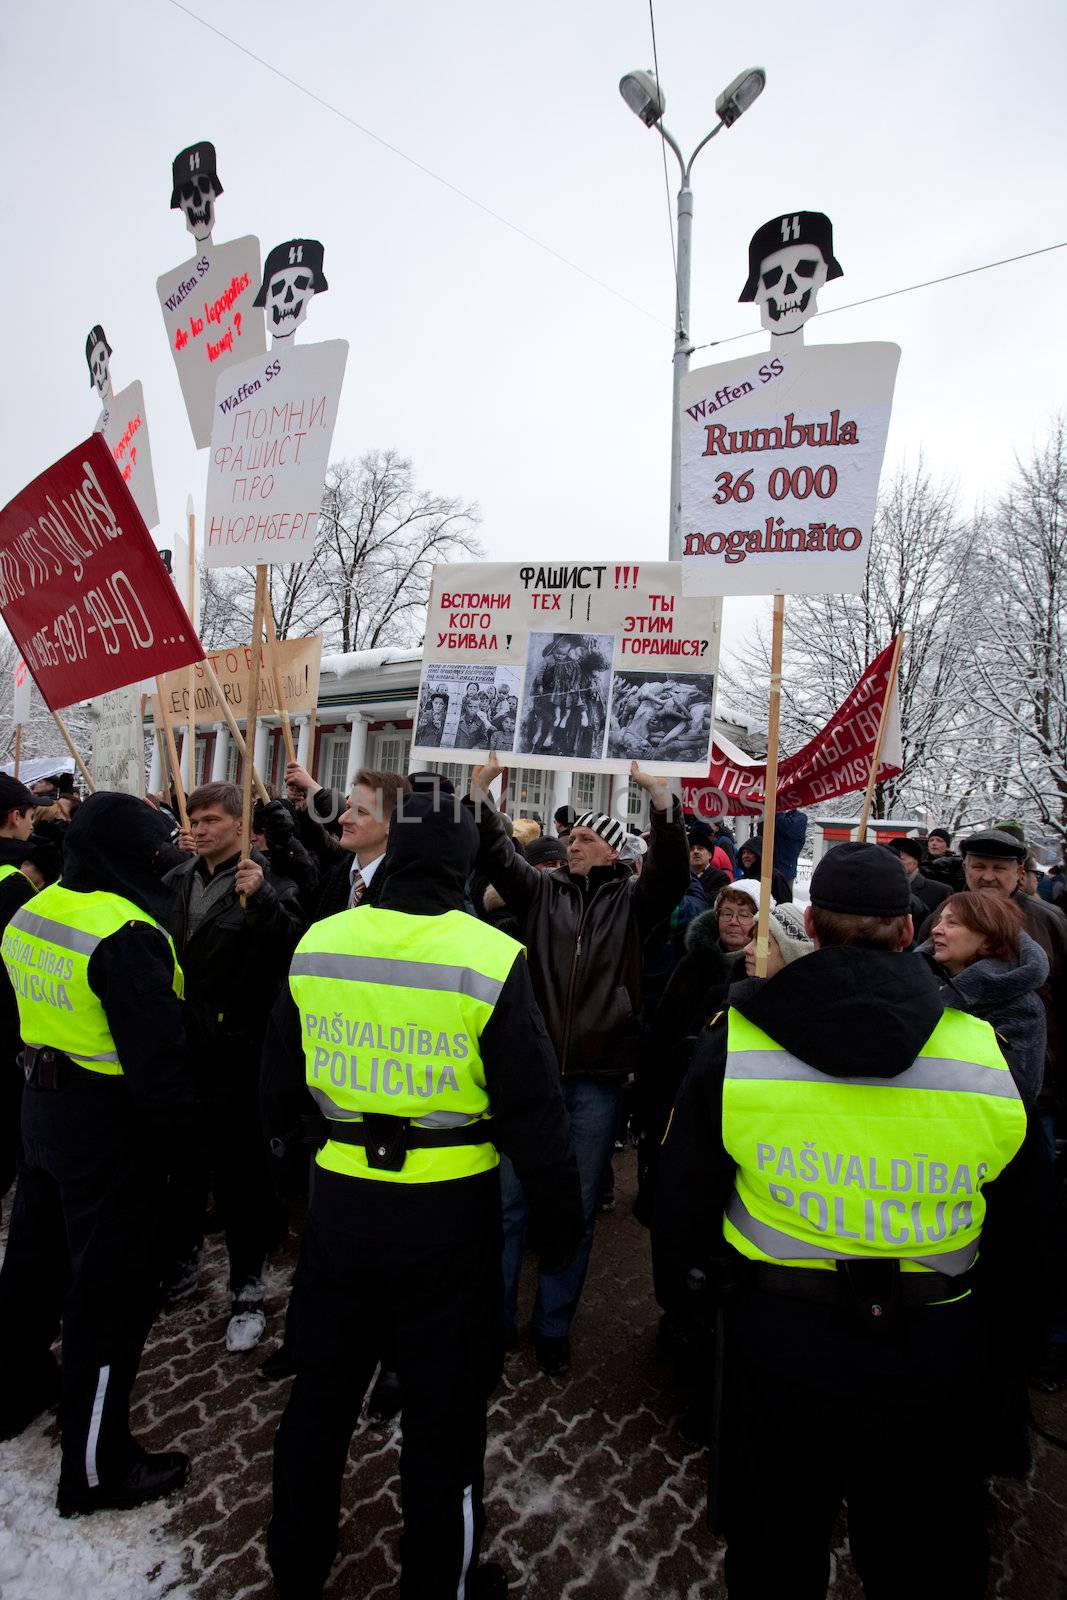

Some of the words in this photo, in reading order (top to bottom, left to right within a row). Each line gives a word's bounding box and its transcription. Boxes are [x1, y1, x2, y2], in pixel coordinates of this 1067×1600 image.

[164, 276, 198, 312] Waffen
[196, 256, 210, 277] SS
[190, 317, 204, 337] ko
[218, 378, 262, 415] Waffen
[264, 359, 282, 382] SS
[684, 378, 755, 424] Waffen
[758, 358, 785, 386] SS
[214, 432, 307, 473] ФАШИСТ
[701, 408, 860, 457] Rumbula
[232, 474, 275, 503] ПРО
[712, 467, 756, 505] 36
[767, 464, 838, 501] 000
[682, 516, 863, 564] nogalināto
[519, 565, 607, 590] ФАШИСТ
[613, 566, 640, 590] !!!
[440, 592, 511, 610] ВСПОМНИ
[531, 593, 561, 611] ТЕХ
[449, 613, 491, 630] КОГО
[648, 595, 675, 613] ТЫ
[436, 632, 498, 650] УБИВАЛ
[623, 616, 674, 634] ЭТИМ
[621, 637, 709, 657] ГОРДИШСЯ?
[3, 934, 74, 981] PAŠVALDĪBAS
[305, 1011, 469, 1059] PAŠVALDĪBAS
[313, 1046, 460, 1098] POLICIJA
[768, 1183, 974, 1244] POLICIJA
